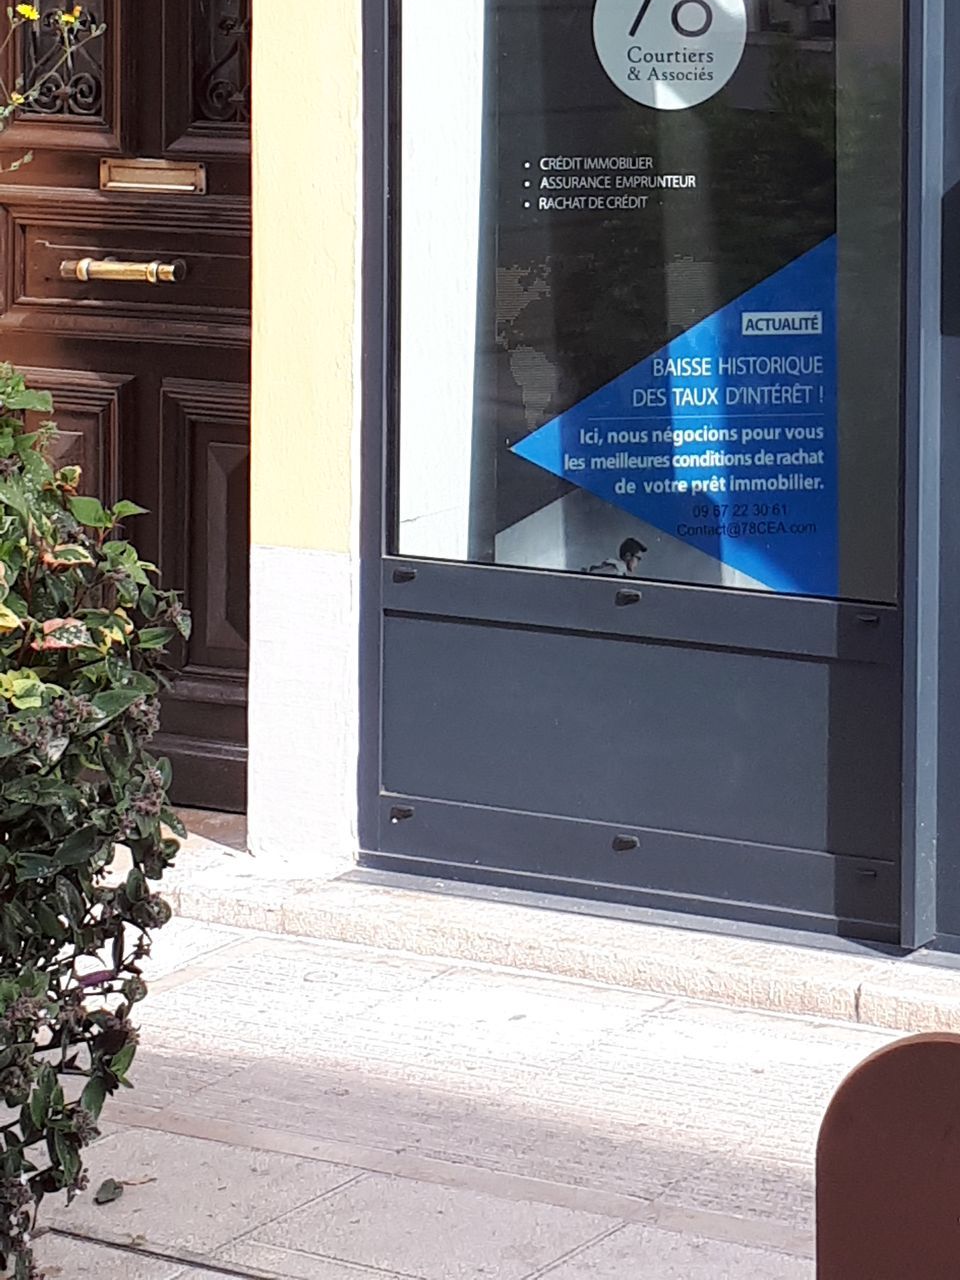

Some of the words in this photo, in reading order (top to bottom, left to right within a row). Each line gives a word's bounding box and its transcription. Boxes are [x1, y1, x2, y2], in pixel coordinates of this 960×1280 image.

[627, 46, 714, 63] Courtiers
[627, 67, 640, 81] &
[647, 66, 714, 81] Associés
[540, 155, 582, 170] CRÉDIT
[584, 157, 653, 169] IMMOBILIER
[540, 176, 611, 189] ASSURANCE
[616, 175, 696, 188] EMPRUNTEUR
[539, 196, 586, 209] RACHAT
[589, 197, 605, 209] DE
[606, 193, 648, 209] CRÉDIT
[745, 314, 819, 332] ACTUALITÉ
[653, 358, 712, 377] BAISSE
[718, 356, 823, 375] HISTORIQUE
[633, 388, 666, 406] DES
[672, 388, 719, 406] TAUX
[580, 429, 603, 445] Ici,
[607, 431, 648, 444] nous
[652, 425, 738, 445] négocions
[742, 429, 782, 444] pour
[785, 427, 824, 440] vous
[564, 454, 585, 470] les
[591, 451, 670, 469] meilleures
[672, 450, 752, 467] conditions
[754, 449, 774, 465] de
[776, 448, 824, 465] rachat
[615, 477, 636, 493] de
[643, 478, 687, 493] votre
[692, 475, 726, 495] prêt
[730, 474, 824, 491] immobilier.
[692, 504, 708, 518] 09
[732, 503, 748, 517] 22
[753, 503, 768, 516] 30
